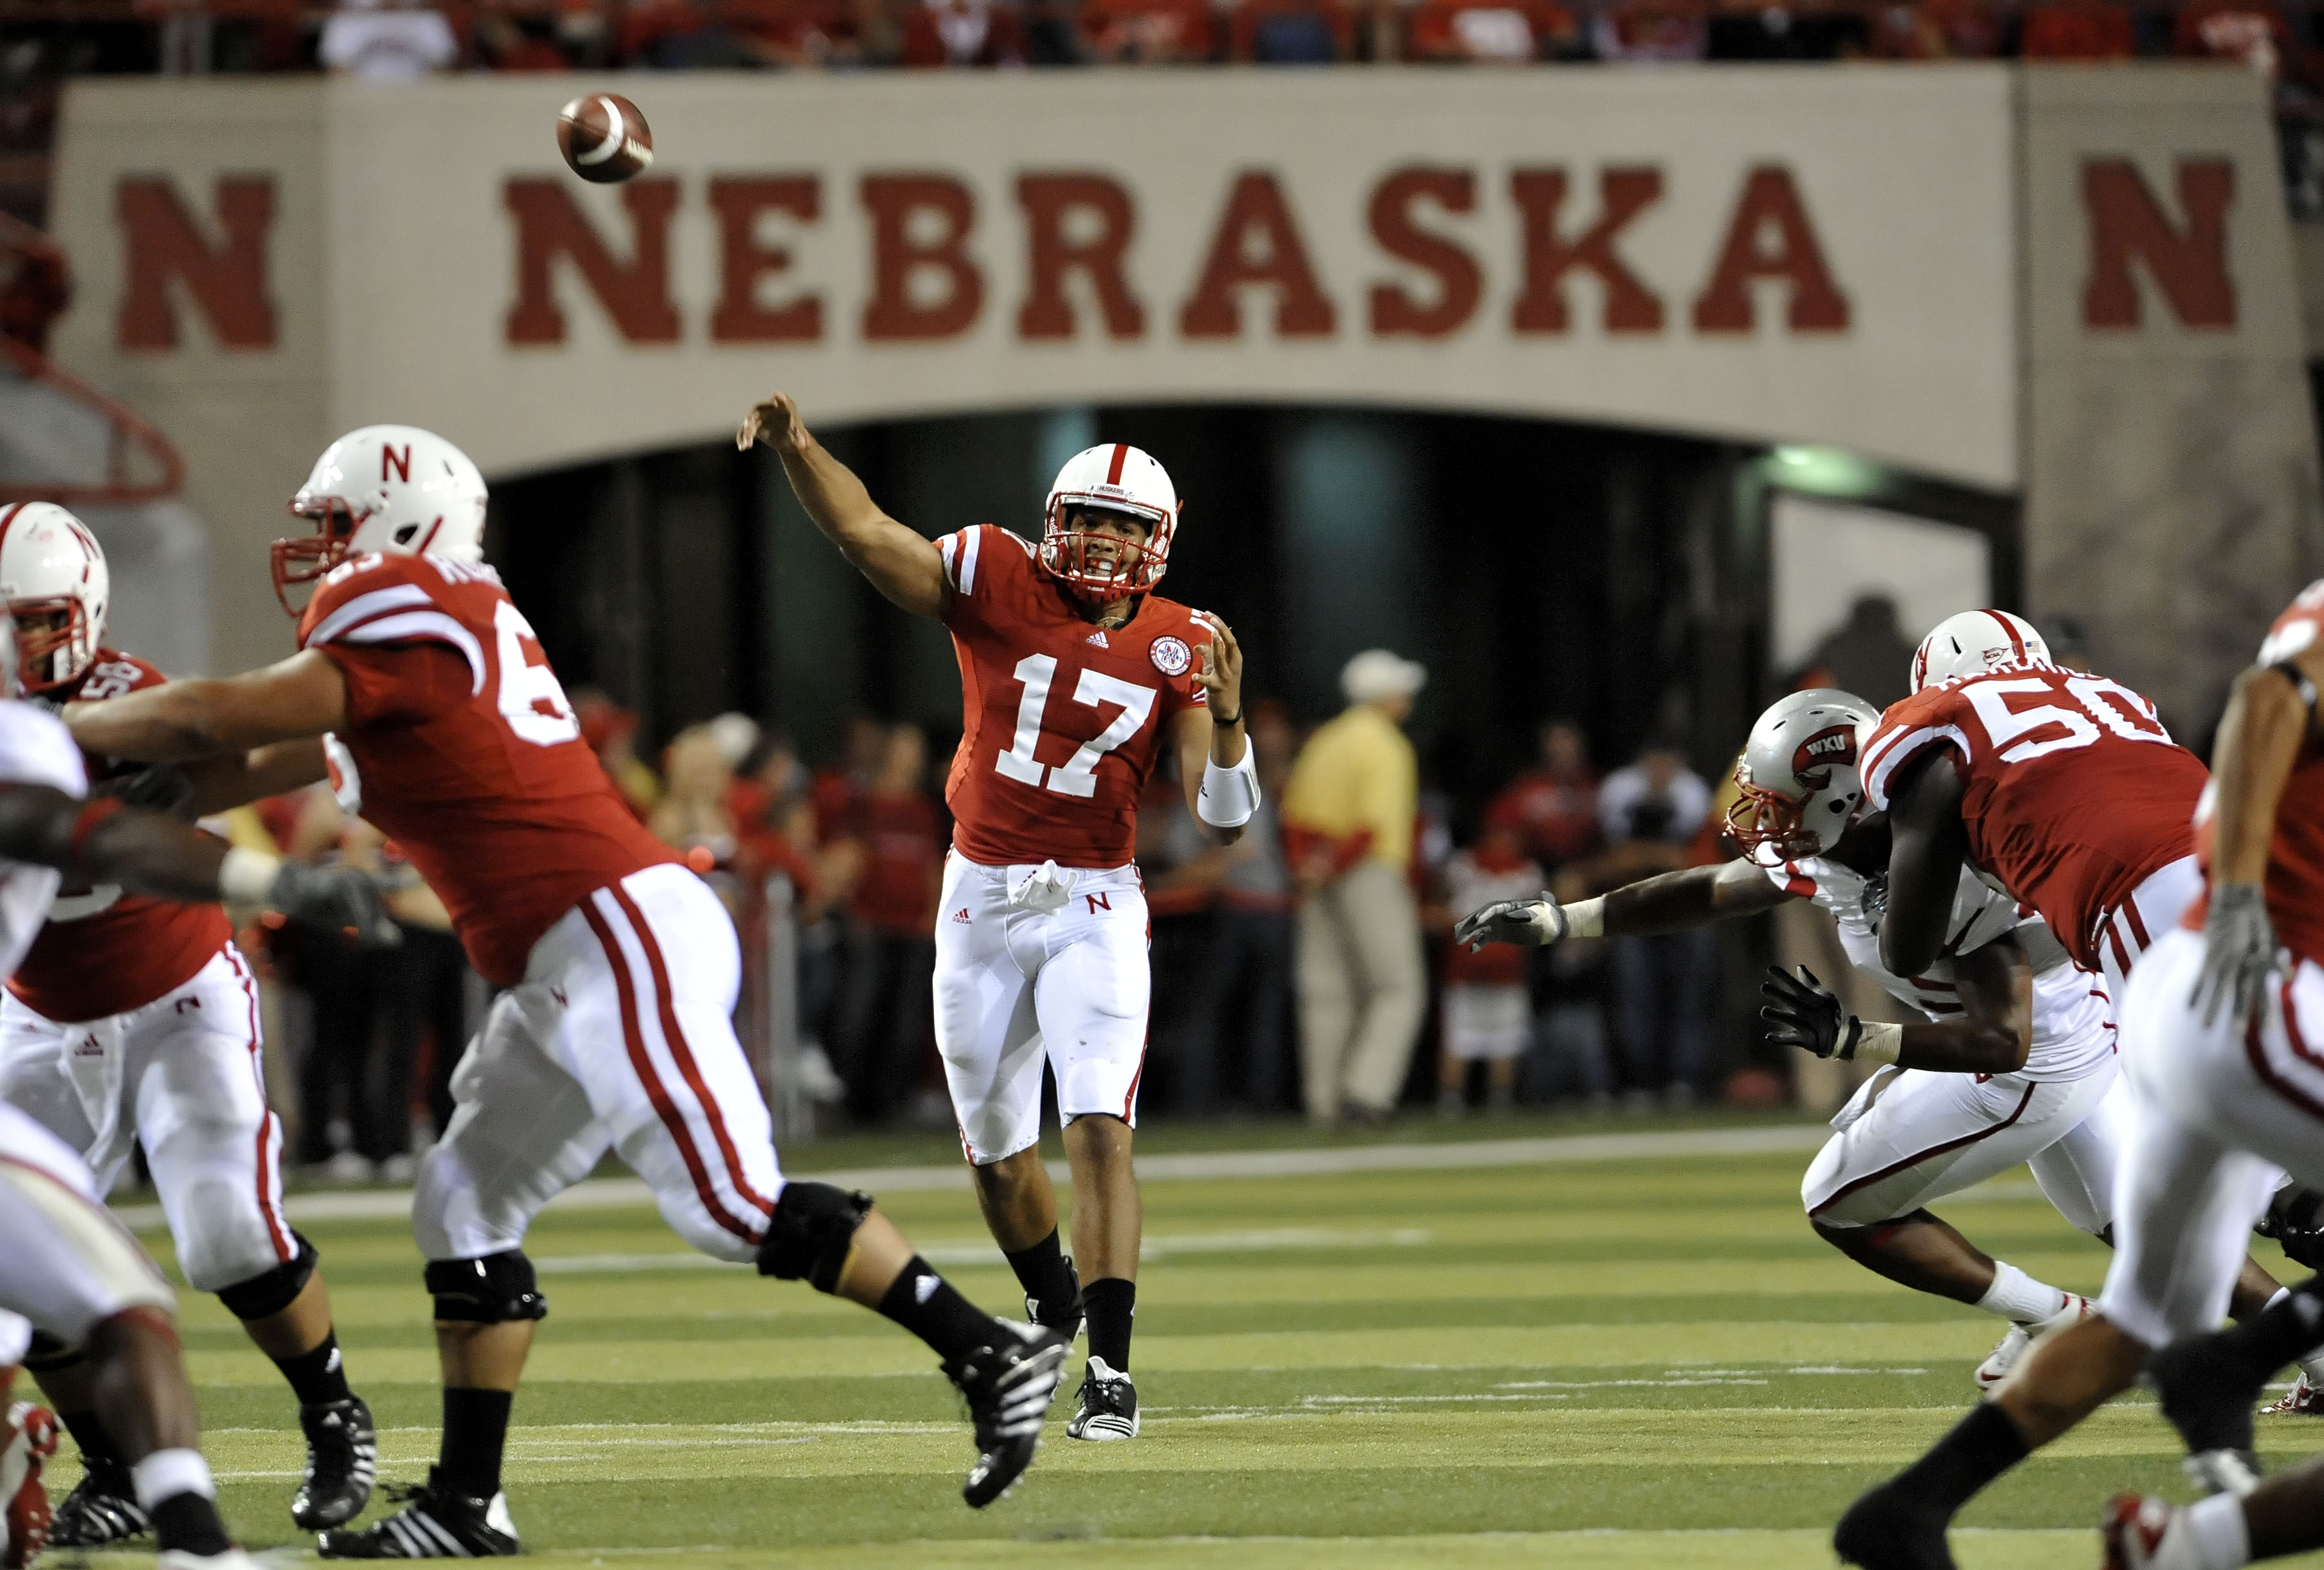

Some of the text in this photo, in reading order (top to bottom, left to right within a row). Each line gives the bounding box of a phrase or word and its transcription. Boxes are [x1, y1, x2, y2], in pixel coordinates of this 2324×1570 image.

[115, 172, 277, 352] N
[503, 165, 1851, 349] NEBRASKA
[2079, 158, 2237, 332] N
[382, 443, 411, 483] N
[1099, 485, 1125, 495] HUSKERS
[1158, 648, 1183, 662] HUSKERS
[995, 653, 1157, 798] 17
[1806, 734, 1846, 756] WKU
[1959, 677, 2178, 763] 50
[1085, 891, 1112, 914] N
